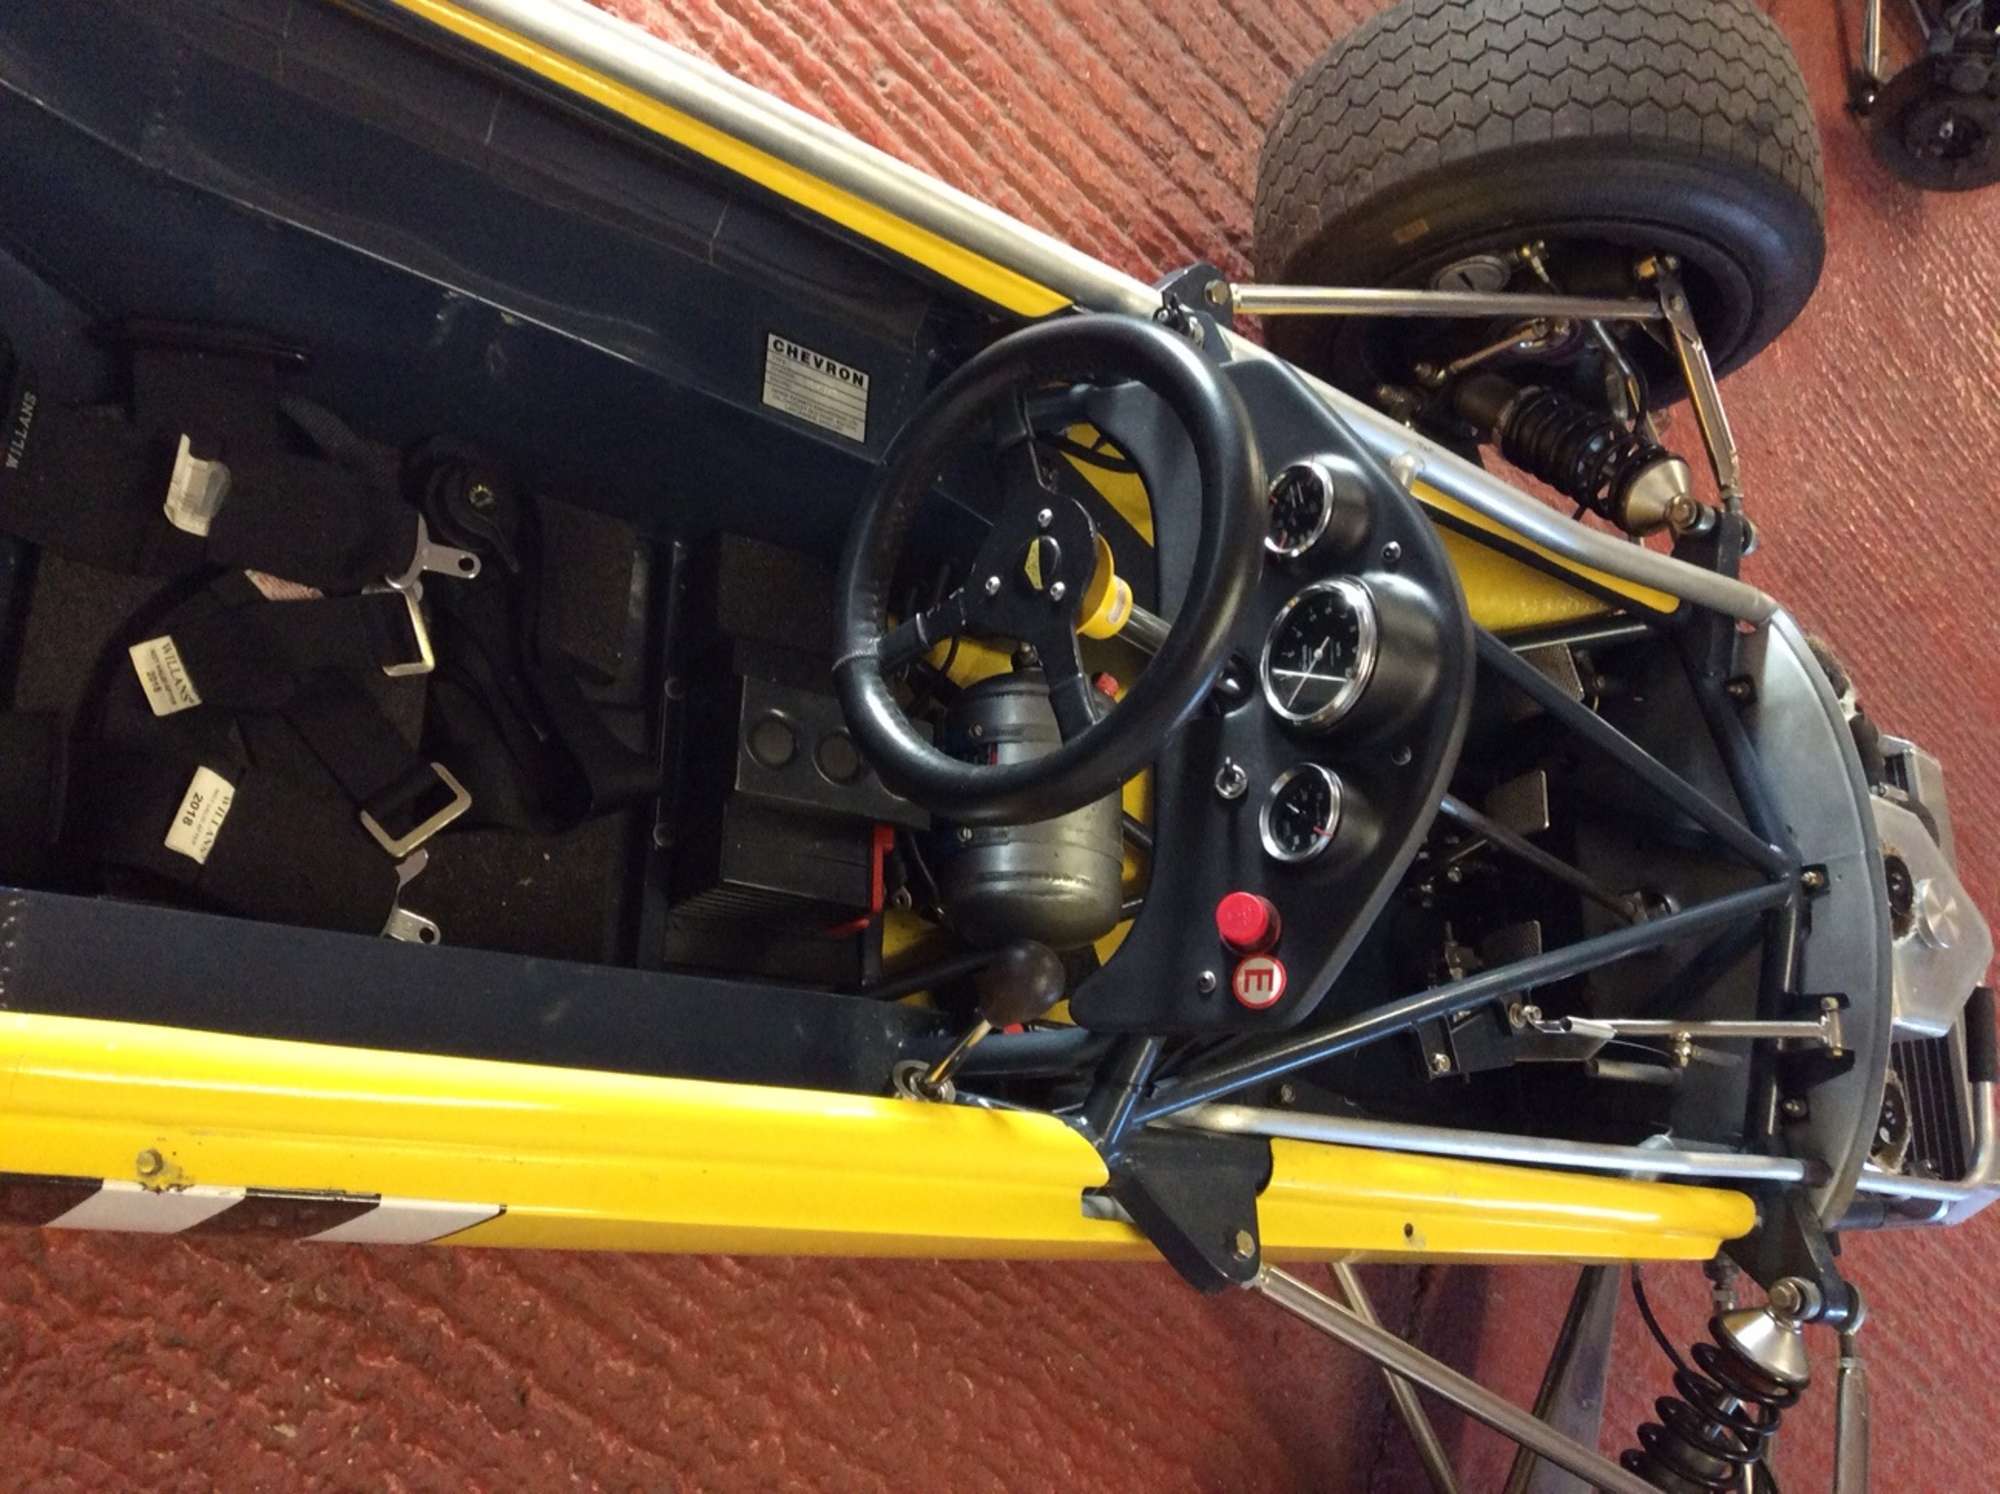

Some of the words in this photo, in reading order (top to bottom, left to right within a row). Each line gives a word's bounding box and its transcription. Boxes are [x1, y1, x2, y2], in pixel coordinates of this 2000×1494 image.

[772, 338, 865, 387] CHEVRON
[5, 391, 37, 470] WILLANS
[182, 792, 204, 827] 2018
[1244, 968, 1274, 993] E
